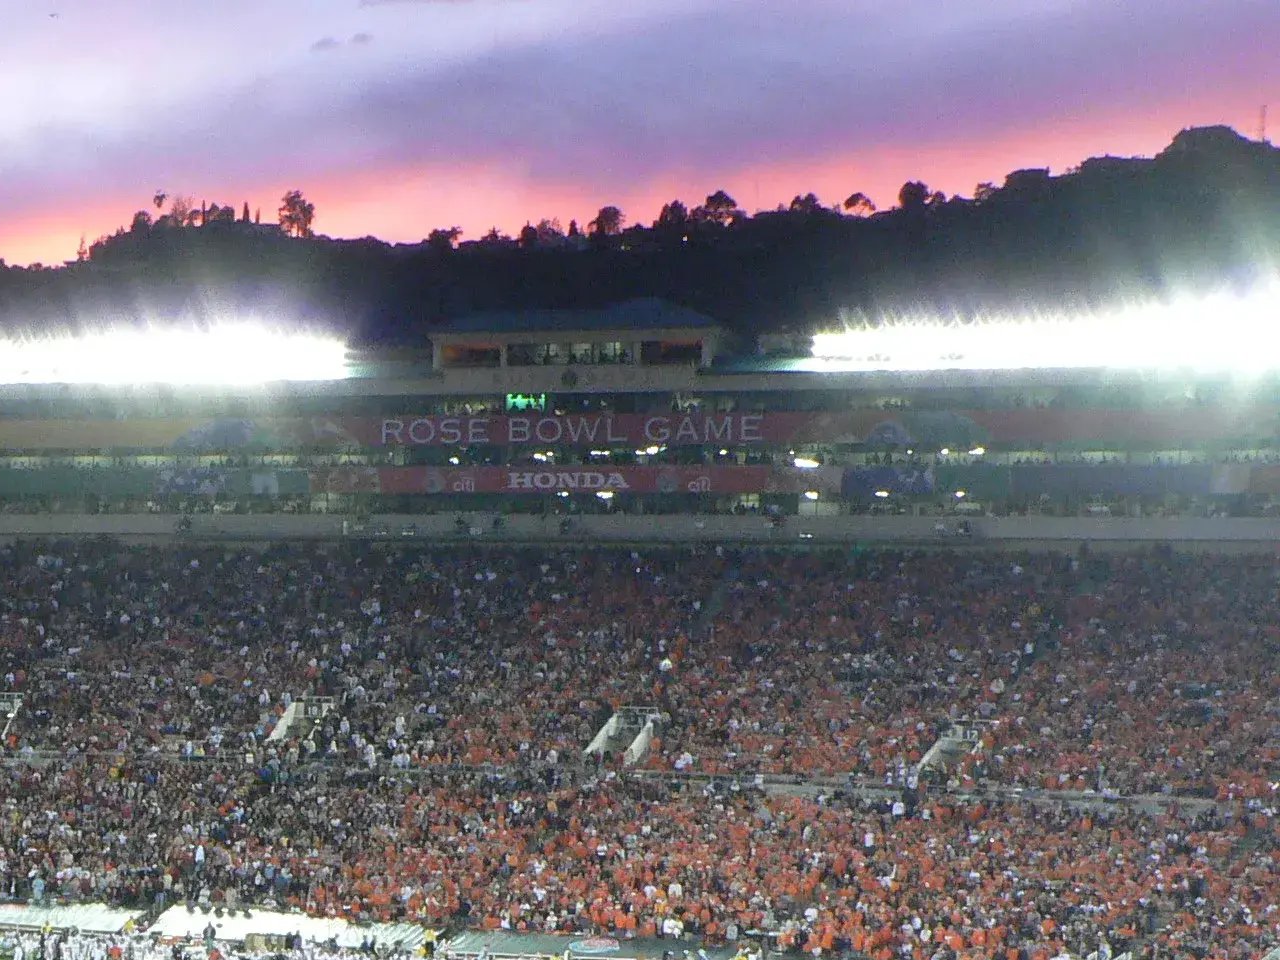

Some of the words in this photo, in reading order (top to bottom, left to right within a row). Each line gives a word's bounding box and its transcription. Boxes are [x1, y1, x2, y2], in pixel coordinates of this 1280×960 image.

[381, 417, 490, 443] ROSE
[509, 416, 627, 442] BOWL
[645, 415, 764, 441] GAME
[507, 471, 630, 490] HONDA
